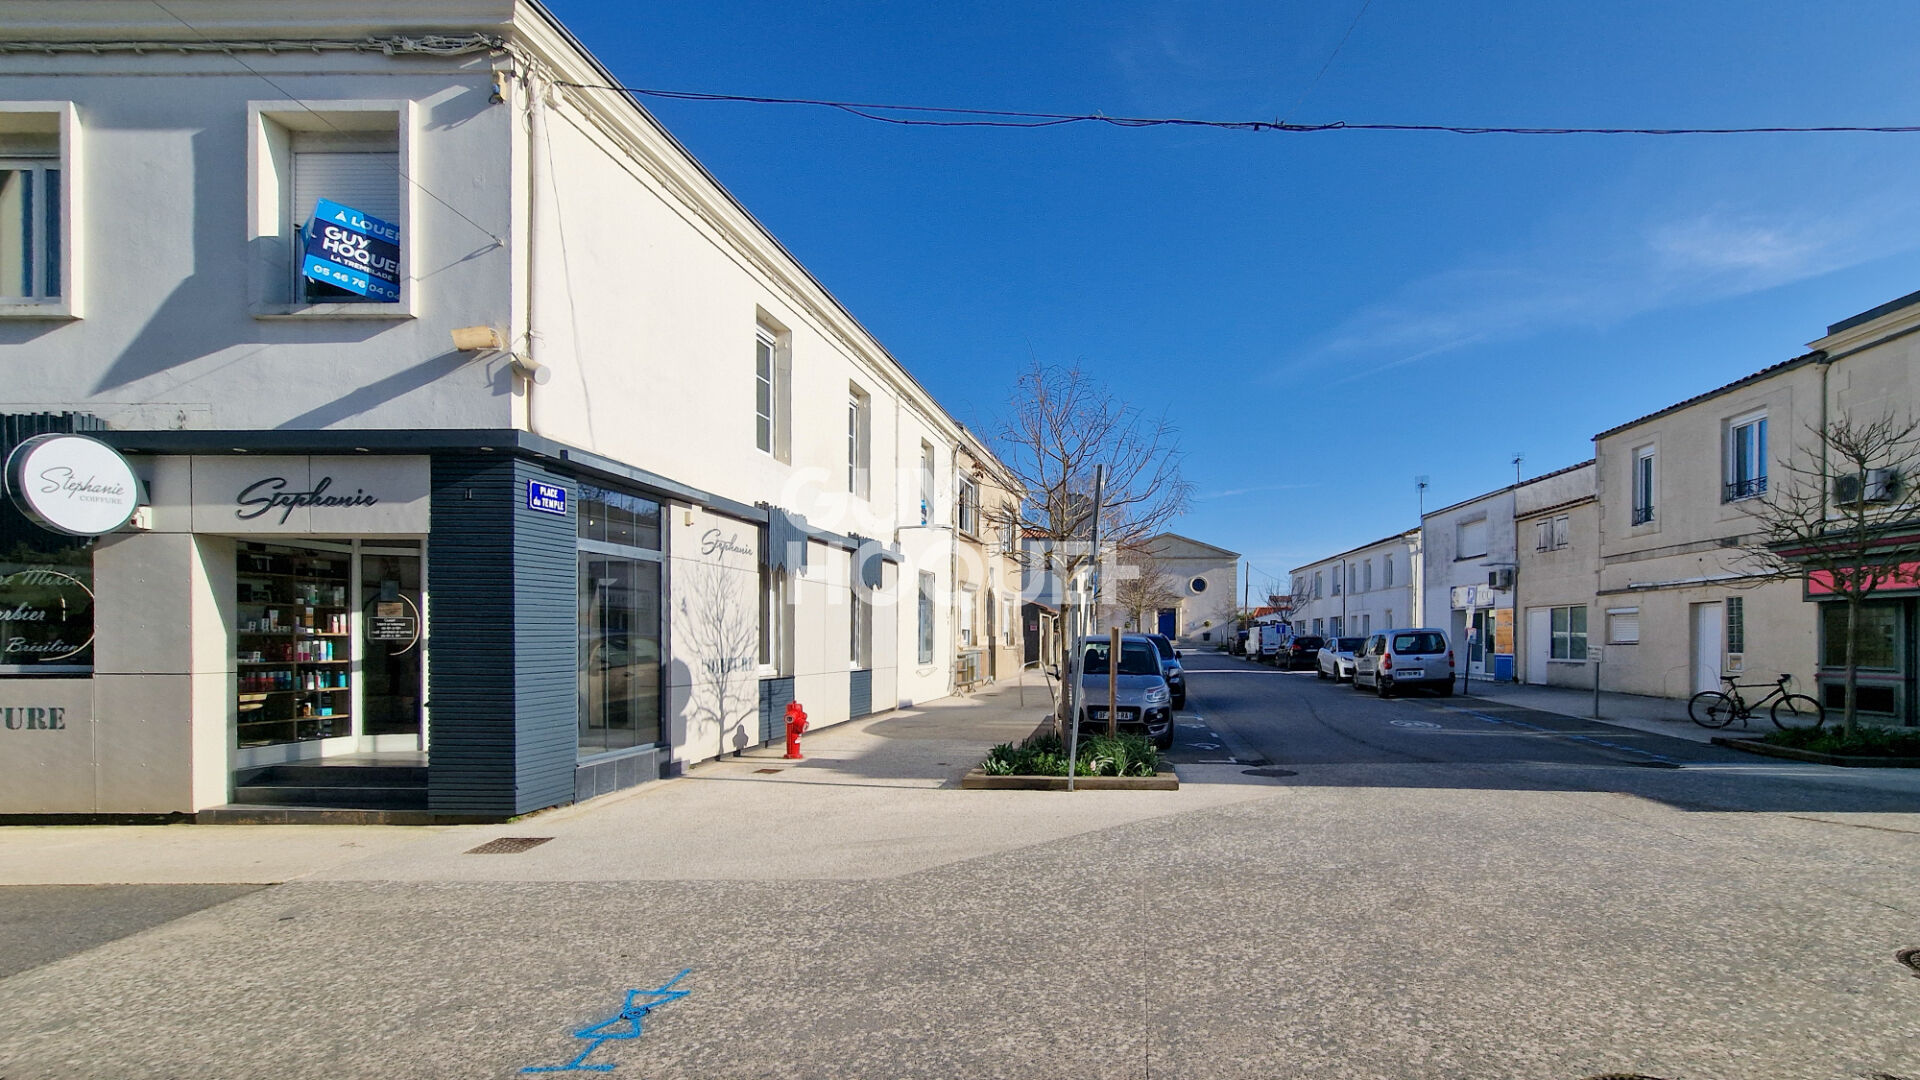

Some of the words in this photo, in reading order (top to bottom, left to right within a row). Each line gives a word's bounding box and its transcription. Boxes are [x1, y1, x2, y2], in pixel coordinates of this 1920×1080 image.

[325, 226, 371, 249] GUY
[313, 264, 330, 276] 05
[79, 494, 123, 505] COIFFURE
[235, 476, 379, 526] Stephanie
[540, 486, 559, 499] PLACE
[541, 497, 565, 511] TEMPLE
[0, 601, 46, 621] rbier
[0, 707, 66, 731] URE
